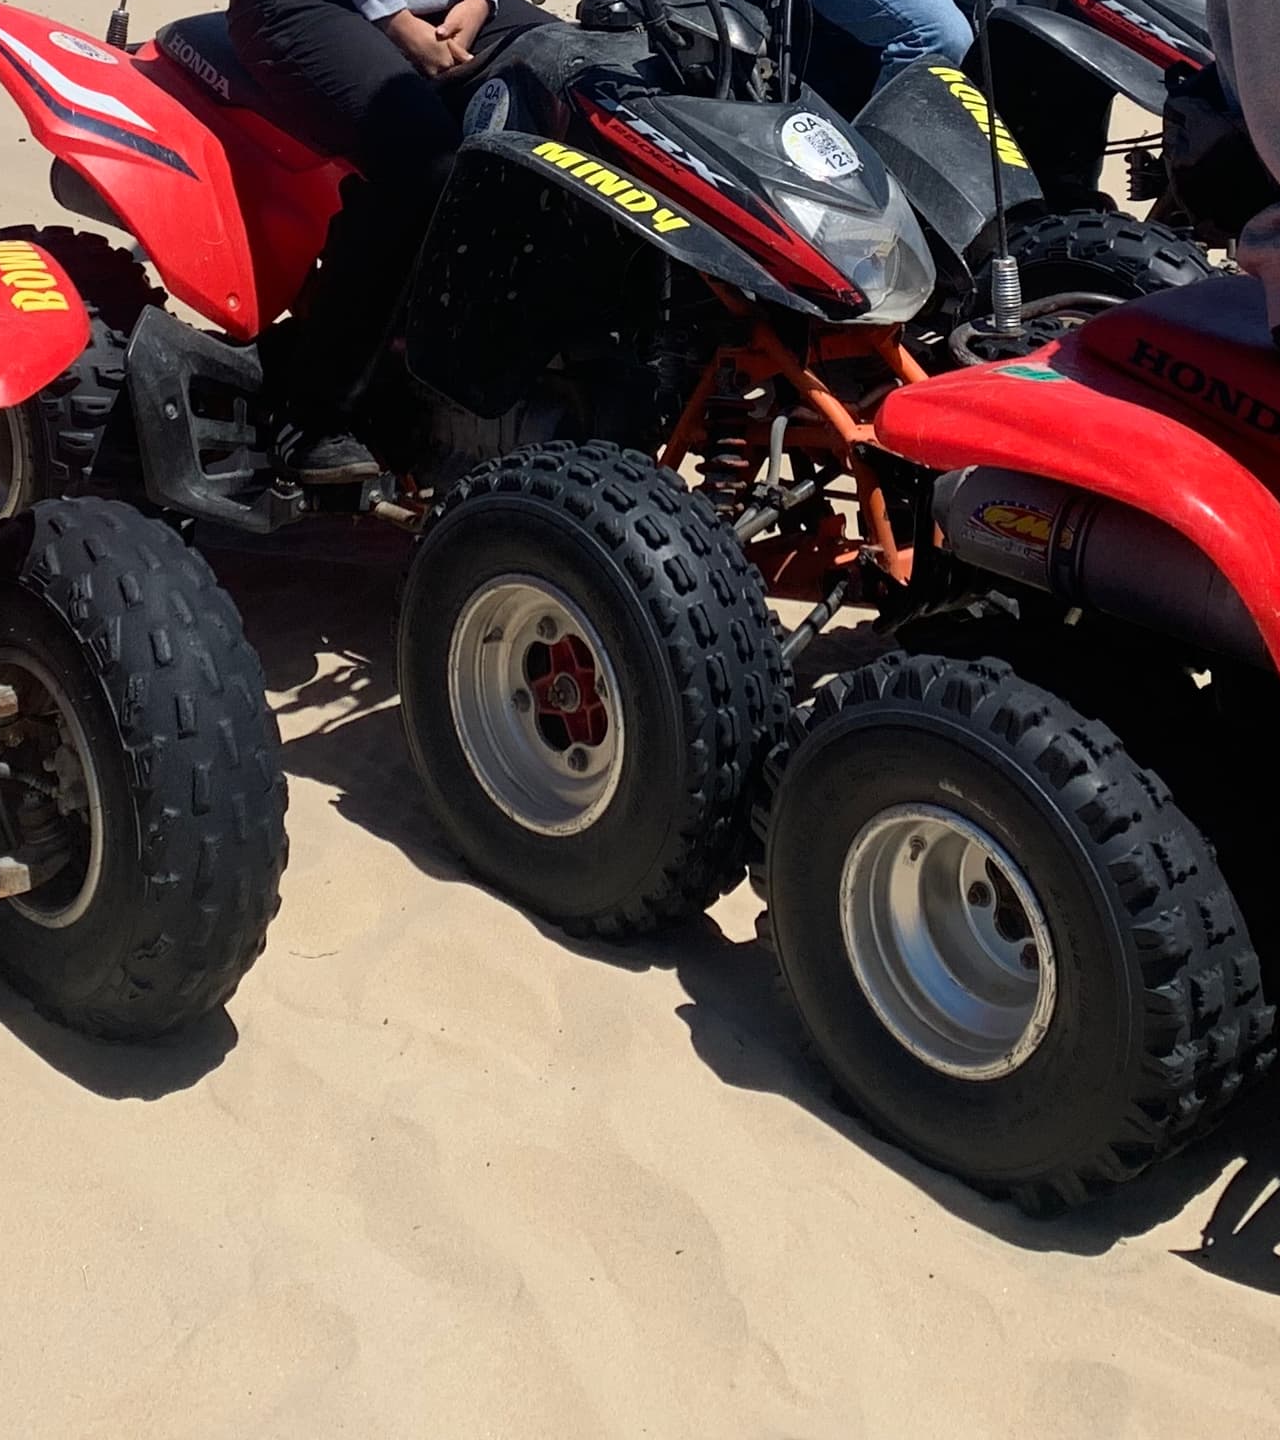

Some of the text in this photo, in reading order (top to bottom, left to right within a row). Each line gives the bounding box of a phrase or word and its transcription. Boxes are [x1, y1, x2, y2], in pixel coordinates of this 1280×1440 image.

[168, 32, 231, 100] HONDA
[793, 117, 823, 134] QA
[531, 142, 691, 233] MINDY
